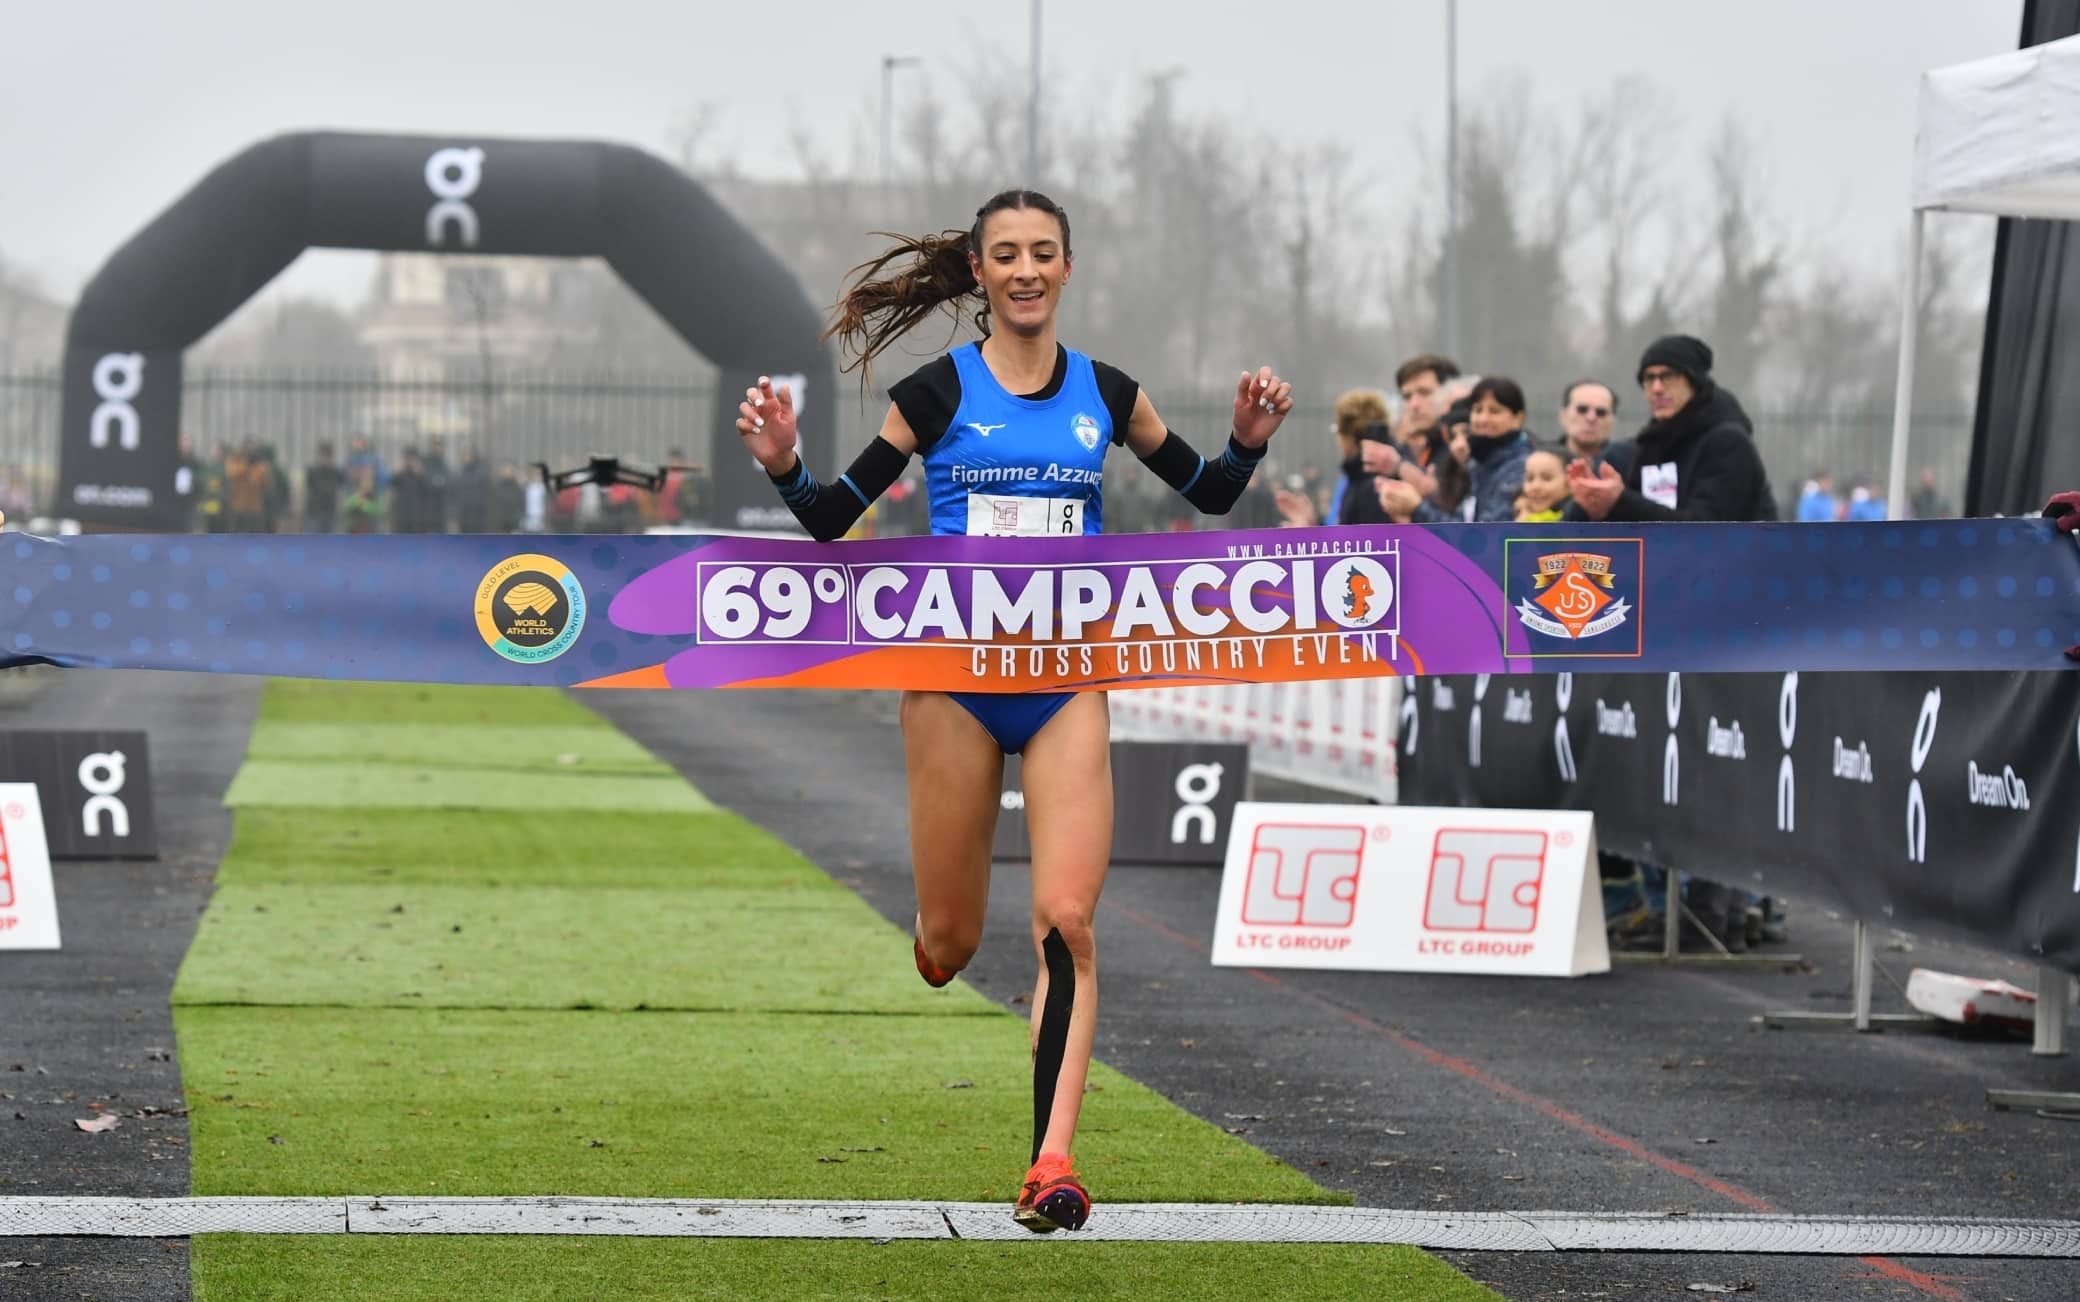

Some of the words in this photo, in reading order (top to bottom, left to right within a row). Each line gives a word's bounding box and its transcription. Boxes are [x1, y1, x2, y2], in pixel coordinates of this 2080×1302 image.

[952, 465, 1039, 483] Fiamme
[1228, 539, 1400, 559] WWW.CAMPACCIO.IT
[482, 577, 497, 599] GOLD
[496, 561, 520, 578] LEVEL
[856, 557, 1394, 641] CAMPACCIO
[506, 627, 555, 635] ATHLETICS
[507, 646, 536, 658] WORLD
[537, 642, 564, 658] CROSS
[562, 606, 582, 644] COUNTRY
[513, 619, 547, 627] WORLD
[972, 646, 1092, 677] CROSS
[1117, 637, 1266, 674] COUNTRY
[1293, 632, 1400, 666] EVENT
[1968, 760, 2007, 807] Dream
[2003, 764, 2030, 811] On.
[1236, 934, 1273, 948] LTC
[1278, 936, 1352, 951] GROUP
[1418, 940, 1456, 954] LTC
[1460, 941, 1534, 957] GROUP
